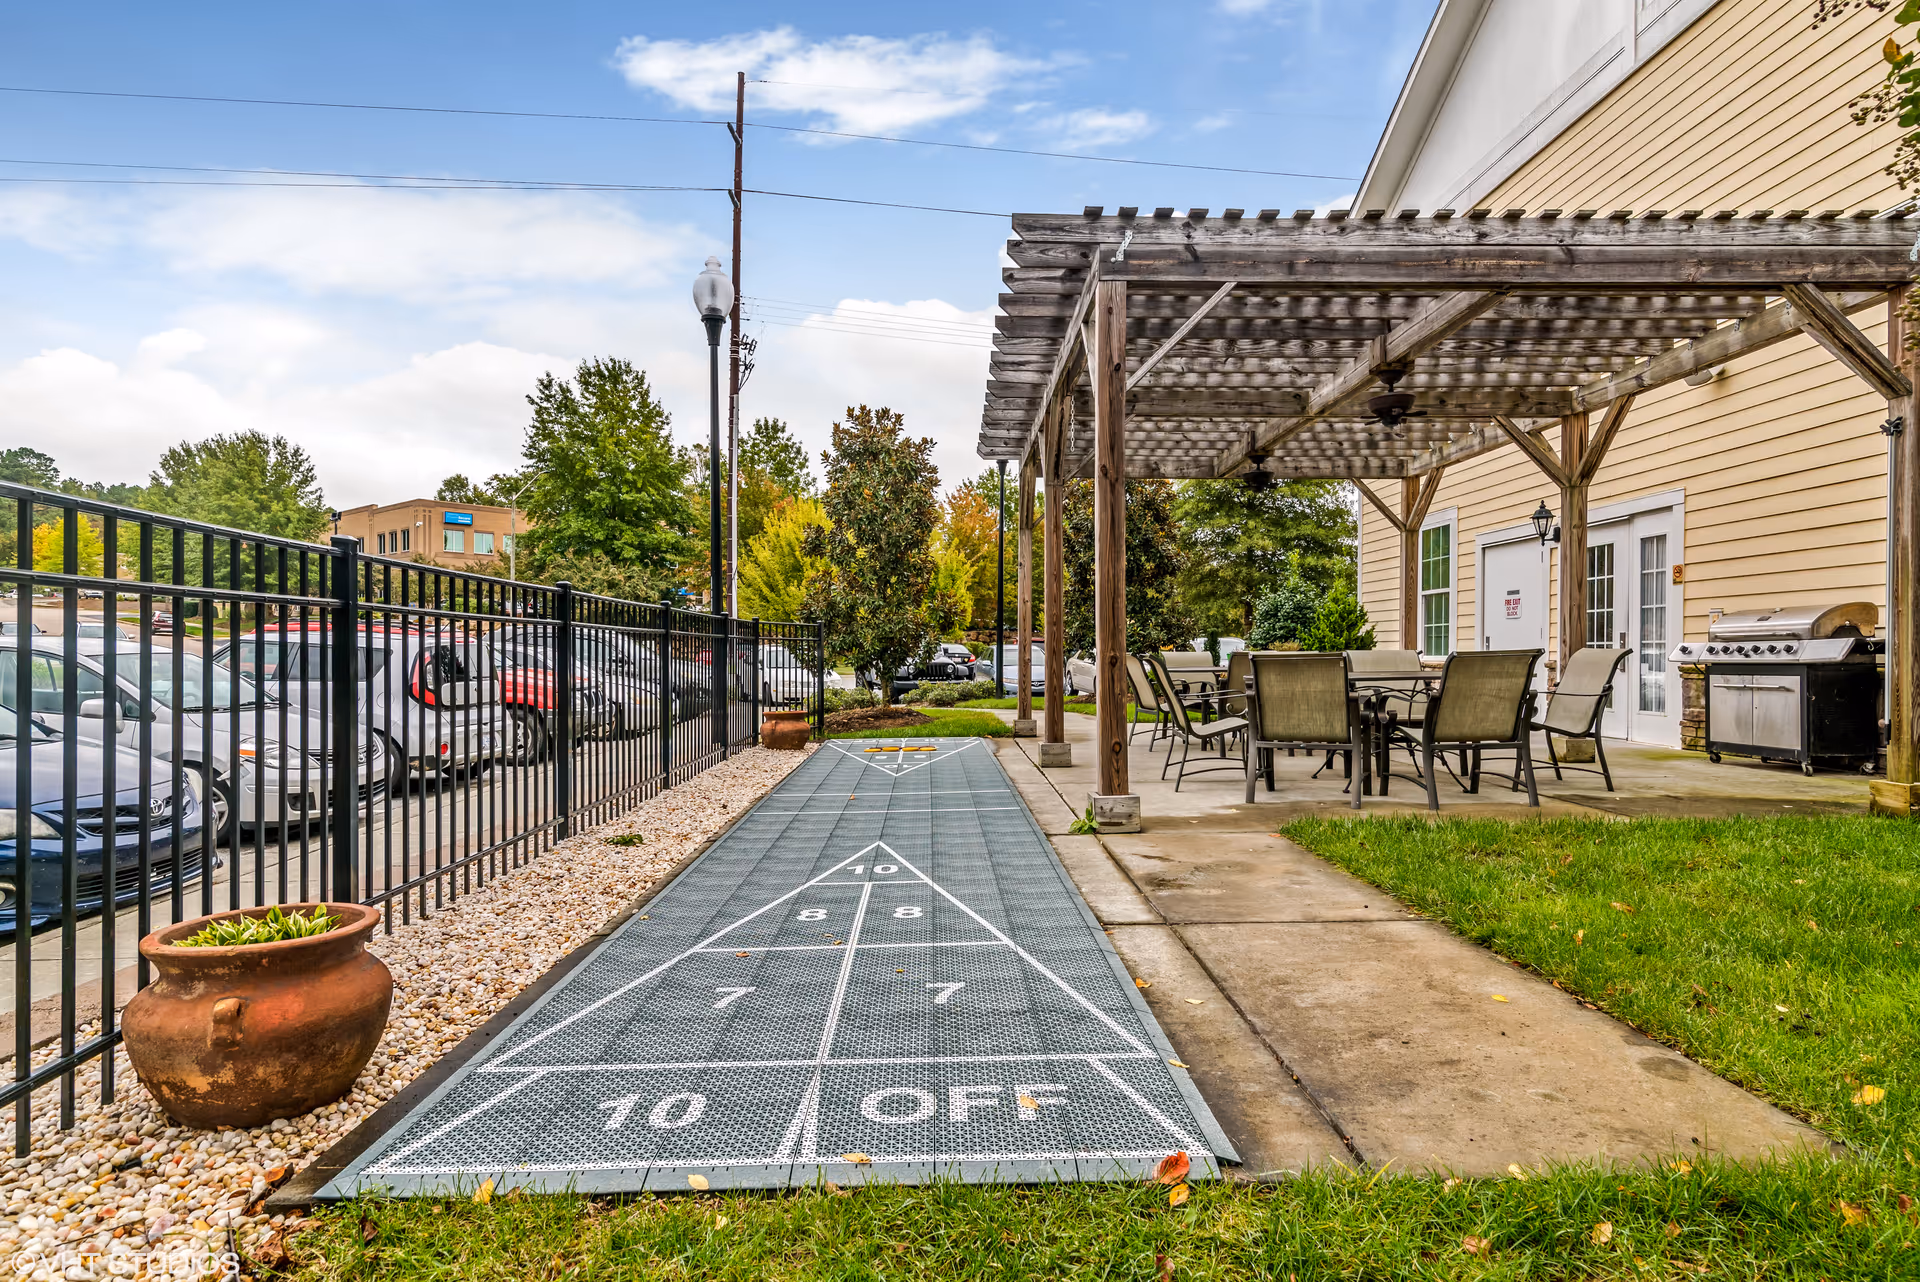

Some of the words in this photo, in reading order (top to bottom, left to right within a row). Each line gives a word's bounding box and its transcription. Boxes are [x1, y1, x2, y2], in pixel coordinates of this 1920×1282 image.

[847, 865, 899, 875] 10
[797, 908, 828, 921] 8
[893, 906, 923, 919] 8
[713, 986, 757, 1009] 7
[926, 982, 966, 1004] 7
[597, 1092, 707, 1130] 10
[860, 1084, 1068, 1124] OFF
